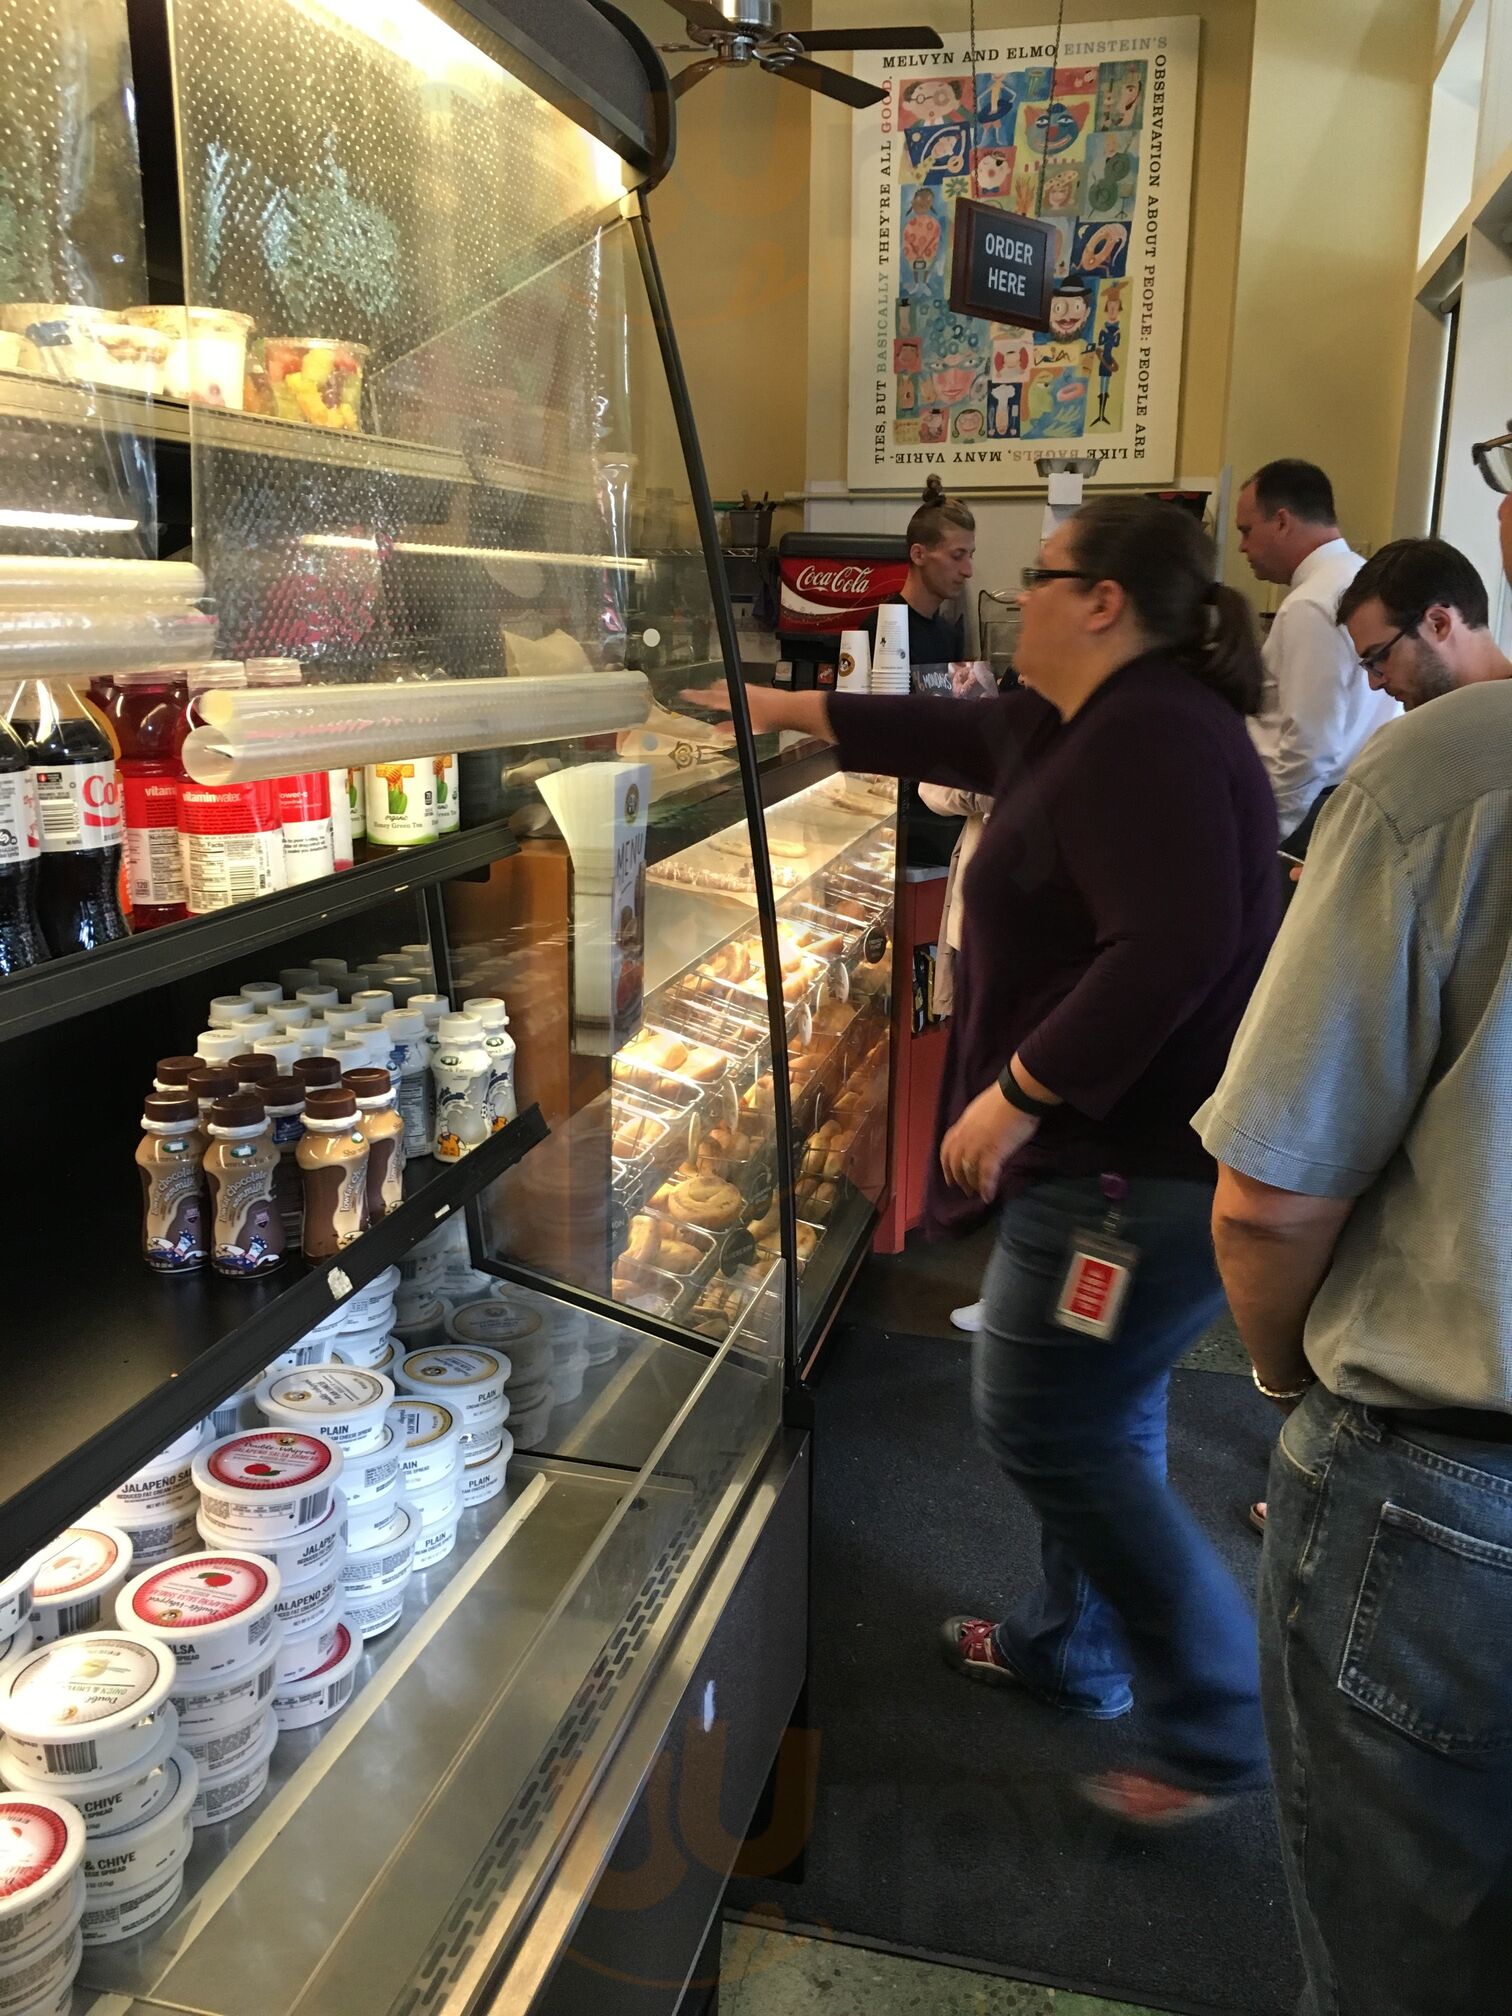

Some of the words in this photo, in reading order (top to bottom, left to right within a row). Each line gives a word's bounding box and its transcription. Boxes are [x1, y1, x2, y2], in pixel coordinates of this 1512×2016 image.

[882, 52, 954, 69] MELVYN
[962, 48, 999, 63] AND
[1006, 44, 1057, 60] ELMO
[1064, 36, 1168, 55] EINSTEIN'S
[1149, 54, 1167, 188] OBSERVATION
[880, 140, 892, 176] ALL
[879, 183, 891, 265] THEY'RE
[1145, 195, 1159, 257] ABOUT
[985, 232, 1033, 265] ORDER
[988, 266, 1027, 296] HERE
[1140, 265, 1156, 341] PEOPLE:
[876, 272, 889, 374] BASICALLY
[876, 380, 887, 416] BUT
[1136, 347, 1151, 416] PEOPLE
[875, 420, 886, 464] TIES,
[953, 451, 1002, 463] MANY
[1086, 448, 1128, 461] LIKE
[1134, 423, 1146, 459] ARE
[616, 832, 644, 884] MENU
[478, 1389, 497, 1402] PLAIN
[320, 1425, 350, 1436] PLAIN
[468, 1474, 491, 1487] PLAIN
[425, 1531, 447, 1547] PLAIN
[84, 1792, 123, 1812] CHIVE
[84, 1860, 96, 1870] &
[97, 1851, 137, 1870] CHIVE
